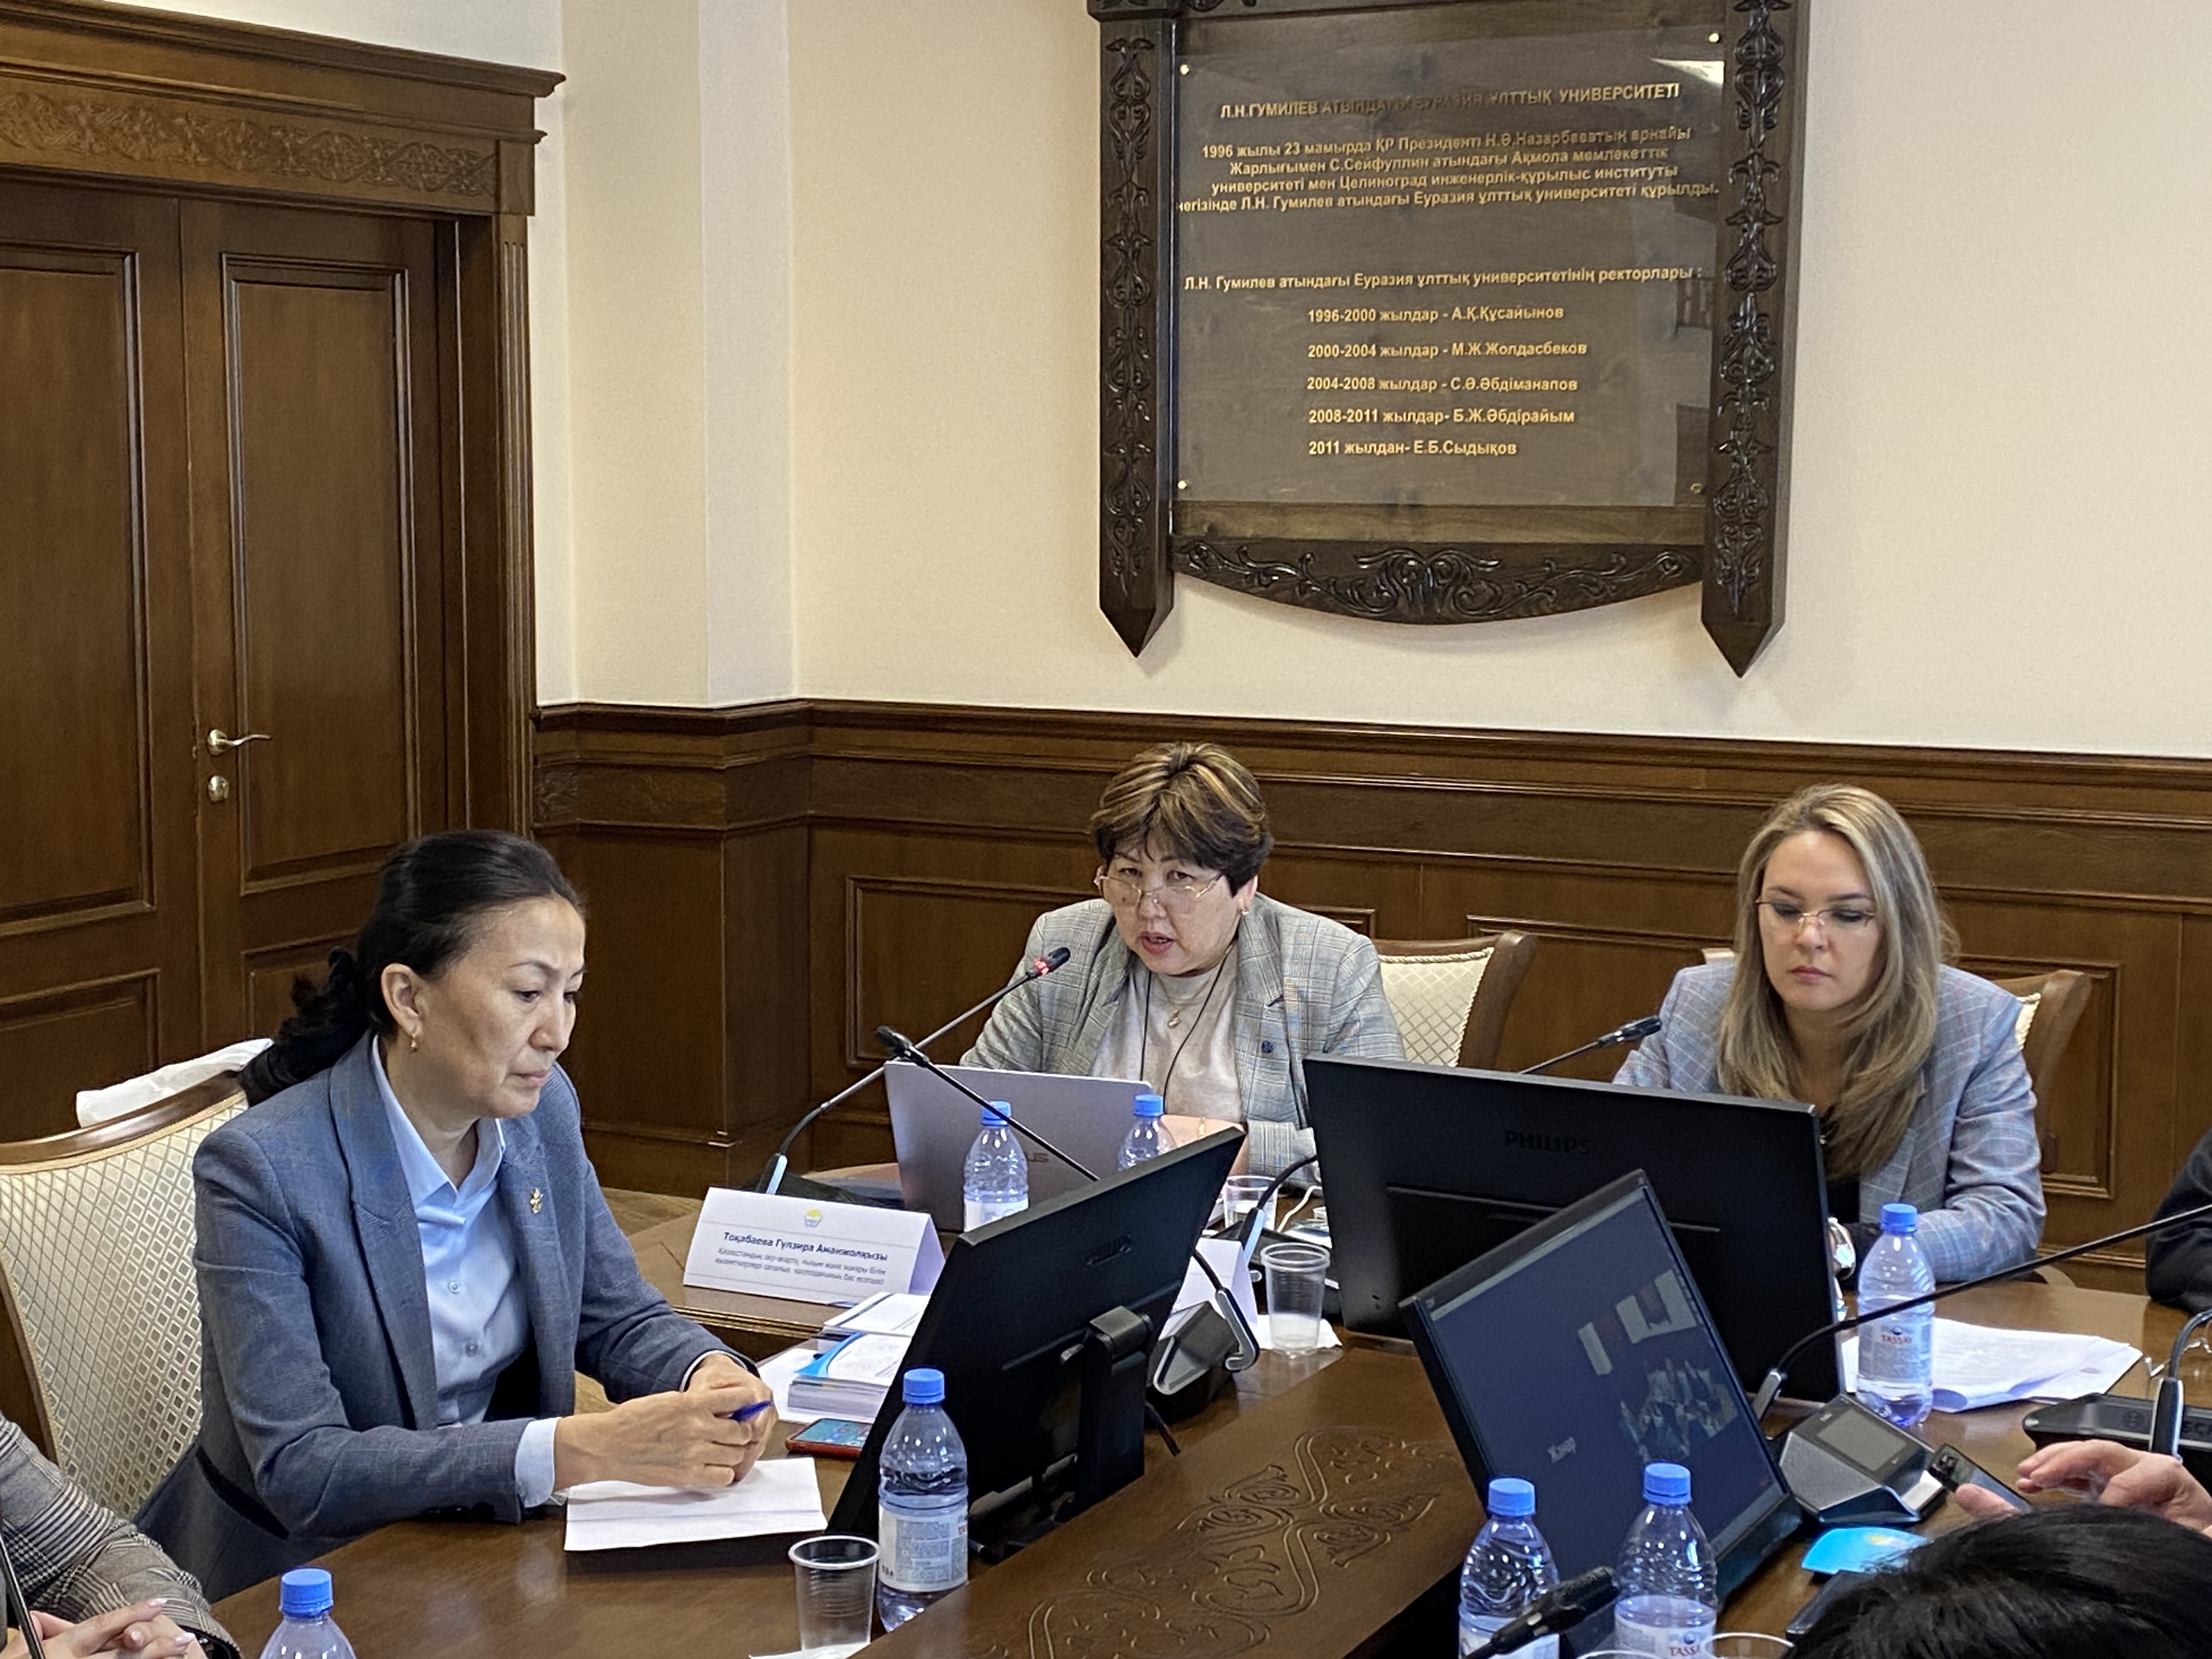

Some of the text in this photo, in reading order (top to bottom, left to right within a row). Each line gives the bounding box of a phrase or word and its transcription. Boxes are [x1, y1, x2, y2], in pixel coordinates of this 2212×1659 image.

[1221, 101, 1318, 119] Л.Н.ГУМИЛЕВ
[1560, 83, 1680, 102] УНИВЕРСИТЕТІ
[1203, 144, 1233, 157] 1996
[1237, 146, 1280, 157] жылы
[1284, 142, 1301, 155] 23
[1305, 141, 1371, 156] мамырда
[1376, 139, 1394, 153] ҚР
[1398, 136, 1481, 153] Президенті
[1230, 161, 1326, 176] Жарлығымен
[1330, 157, 1428, 173] С.Сейфуллин
[1433, 154, 1507, 167] атындағы
[1512, 150, 1568, 165] Ақмола
[1211, 178, 1304, 196] университеті
[1308, 180, 1335, 190] мен
[1340, 176, 1427, 190] Целиноград
[1595, 166, 1678, 180] институты
[1240, 196, 1269, 210] Л.Н.
[1273, 195, 1333, 212] Гумилев
[1338, 194, 1409, 207] атындағы
[1414, 191, 1475, 207] Еуразия
[1536, 184, 1637, 202] университеті
[1184, 276, 1212, 290] Л.Н.
[1216, 276, 1276, 292] Гумилев
[1279, 275, 1350, 289] атындағы
[1354, 273, 1413, 289] Еуразия
[1599, 267, 1693, 283] ректорлары
[1308, 309, 1376, 323] 1996-2000
[1380, 309, 1439, 324] жылдар
[1308, 344, 1376, 358] 2000-2004
[1380, 345, 1439, 359] жылдар
[1307, 377, 1376, 390] 2004-2008
[1379, 380, 1438, 393] жылдар
[1308, 409, 1379, 423] 2008-2011
[1308, 441, 1340, 455] 2011
[1504, 1131, 1590, 1155] PHILIPS
[1668, 1644, 1701, 1657] TASSA
